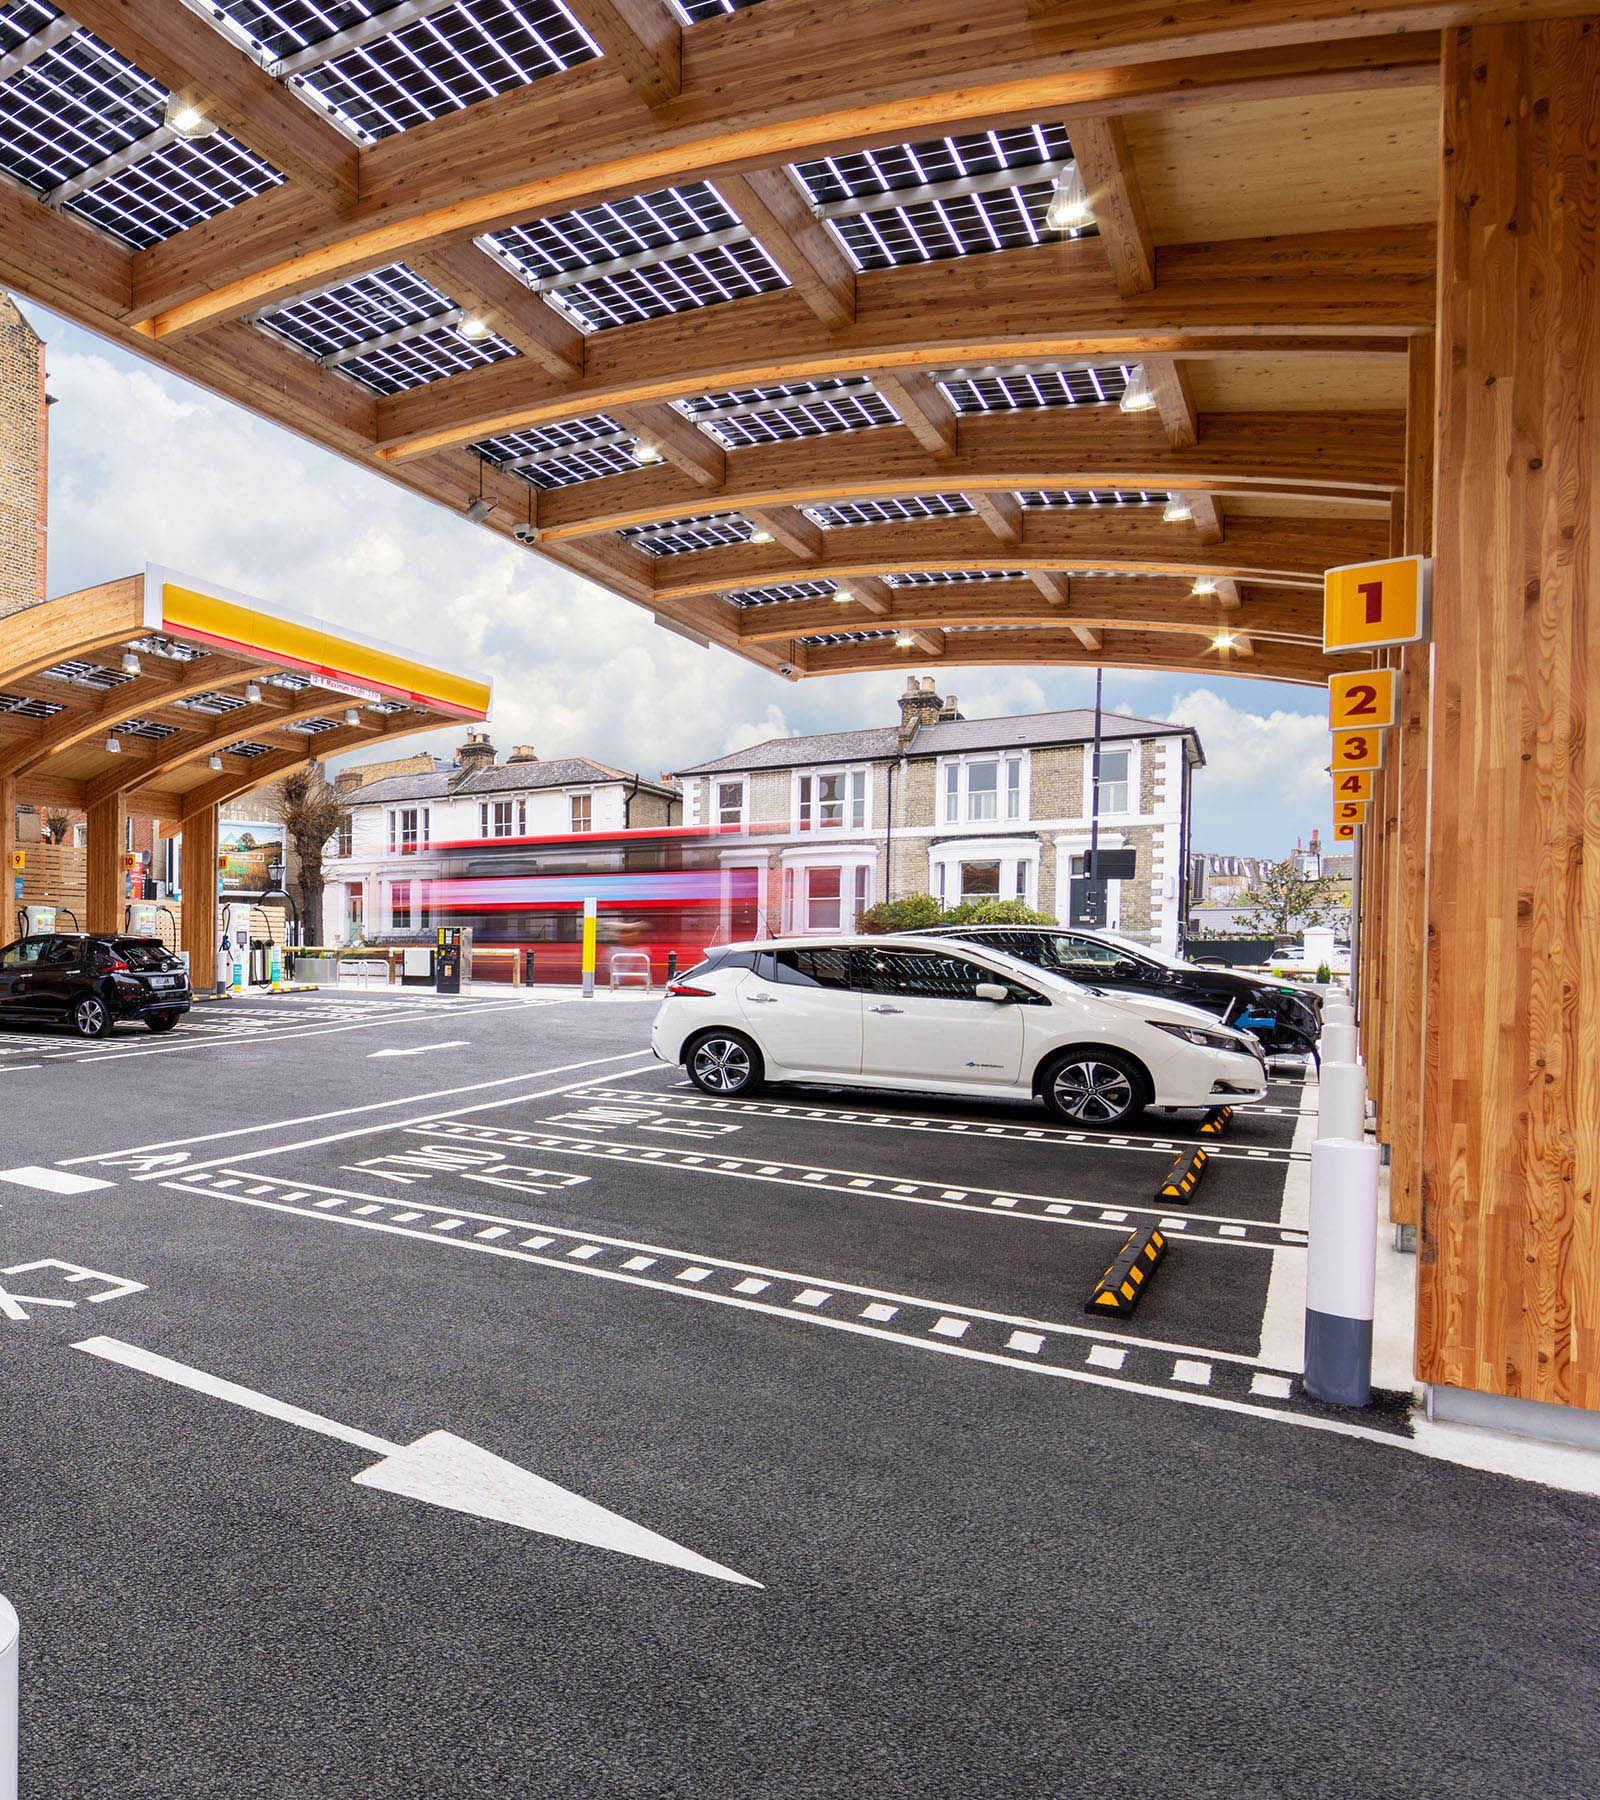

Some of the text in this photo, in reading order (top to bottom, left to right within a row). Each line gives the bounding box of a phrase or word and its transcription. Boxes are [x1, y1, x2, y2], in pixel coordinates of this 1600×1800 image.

[1357, 581, 1383, 624] 1
[1344, 684, 1377, 716] 2
[1343, 736, 1368, 760] 3
[1340, 775, 1362, 793] 4
[1341, 802, 1357, 818] 5
[125, 857, 133, 866] 10
[534, 1106, 663, 1133] ONLY
[637, 1118, 743, 1140] EV
[338, 1145, 506, 1185] ONLY
[459, 1164, 593, 1196] EV
